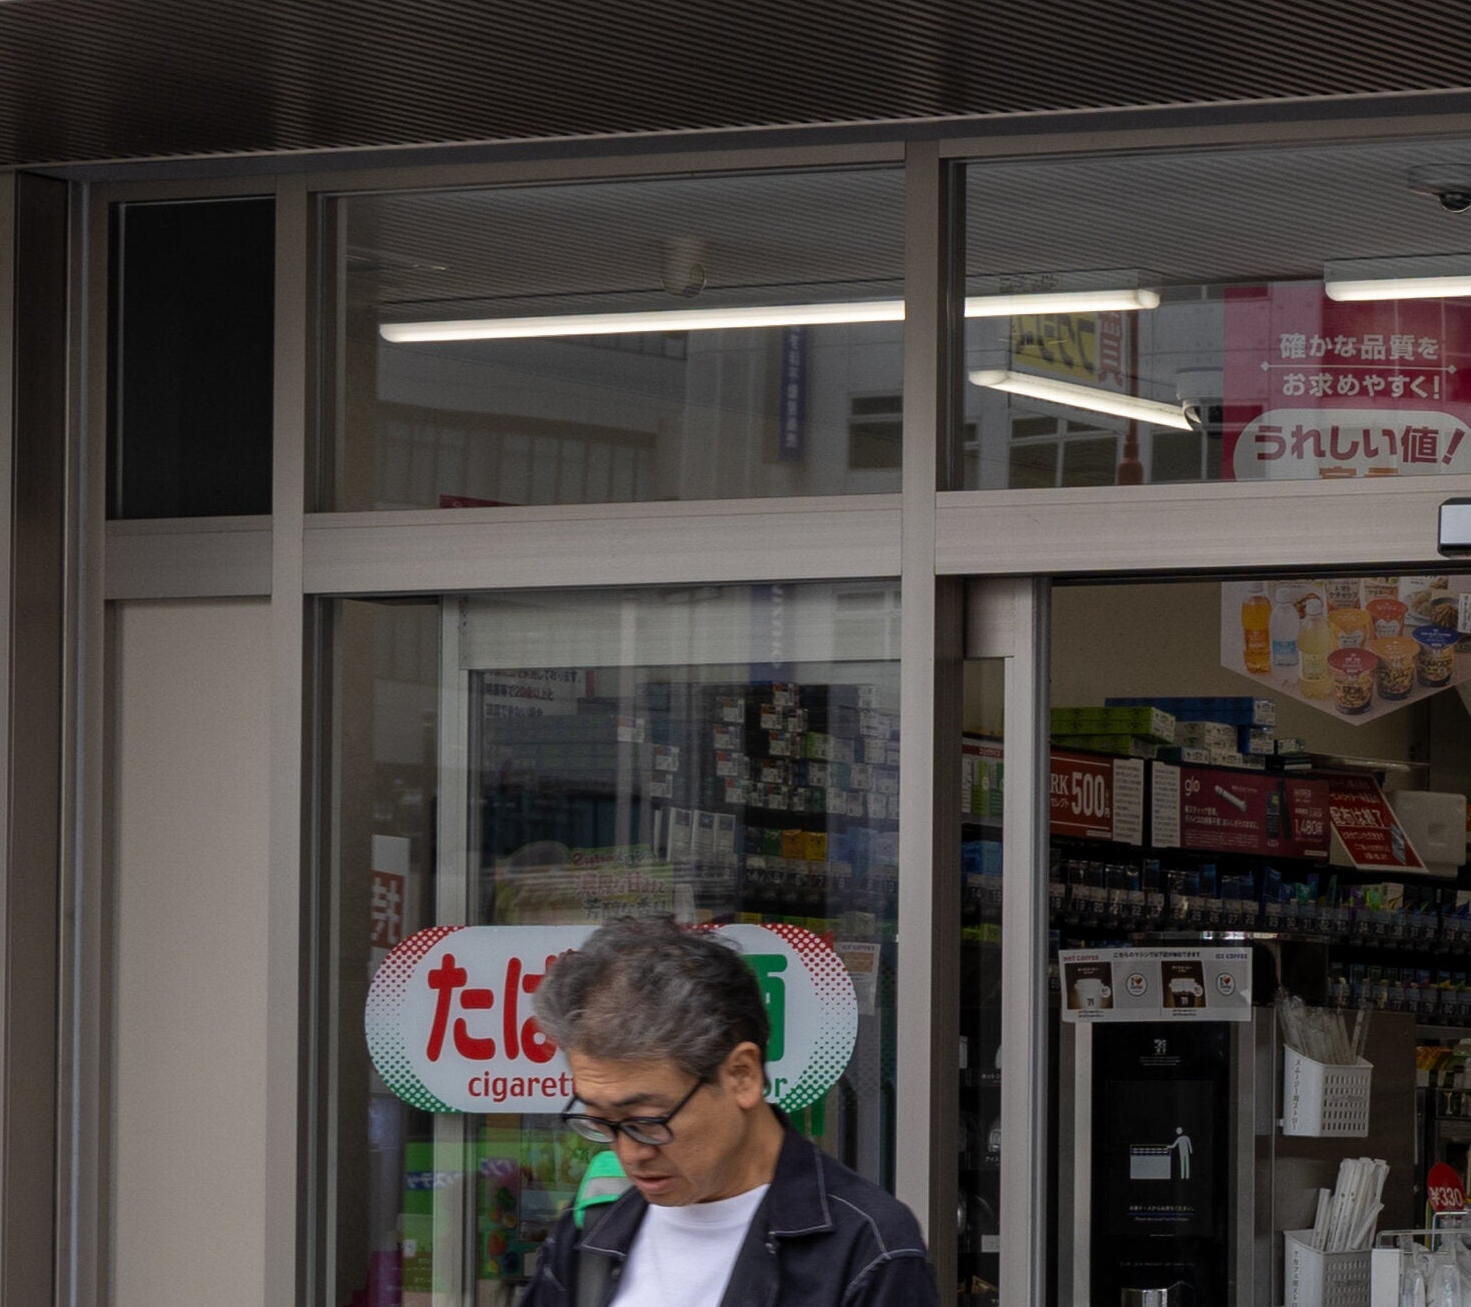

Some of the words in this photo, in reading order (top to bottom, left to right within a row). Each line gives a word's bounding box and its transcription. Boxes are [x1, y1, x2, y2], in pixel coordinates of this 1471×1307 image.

[1280, 333, 1440, 361] 確かな品質を
[1282, 373, 1441, 400] お求めやすく!
[1253, 424, 1467, 466] うれしい値!
